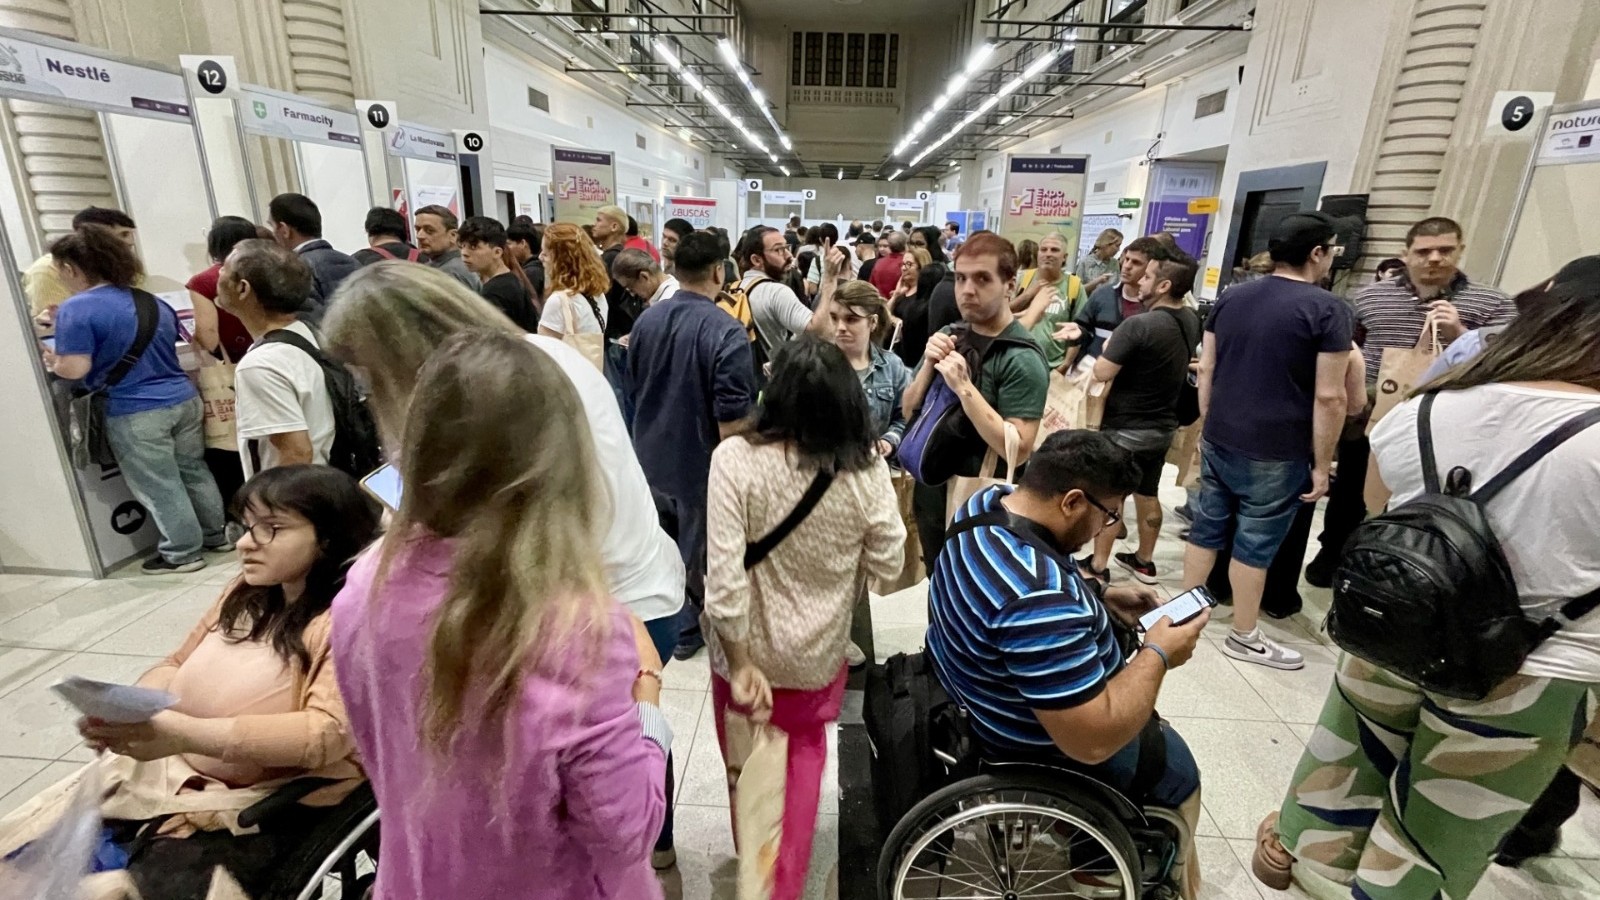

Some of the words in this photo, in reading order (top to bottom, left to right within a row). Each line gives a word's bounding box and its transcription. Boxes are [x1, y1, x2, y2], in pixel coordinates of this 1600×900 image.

[46, 58, 111, 83] Nestlé
[203, 69, 222, 87] 12
[283, 107, 333, 128] Farmacity
[372, 109, 385, 123] 11
[1511, 106, 1525, 122] 5
[467, 137, 480, 147] 10
[1036, 188, 1065, 199] Expo
[1034, 197, 1078, 208] Empleo
[672, 207, 710, 218] ¿BUSCÁS
[1033, 206, 1071, 217] Barrial
